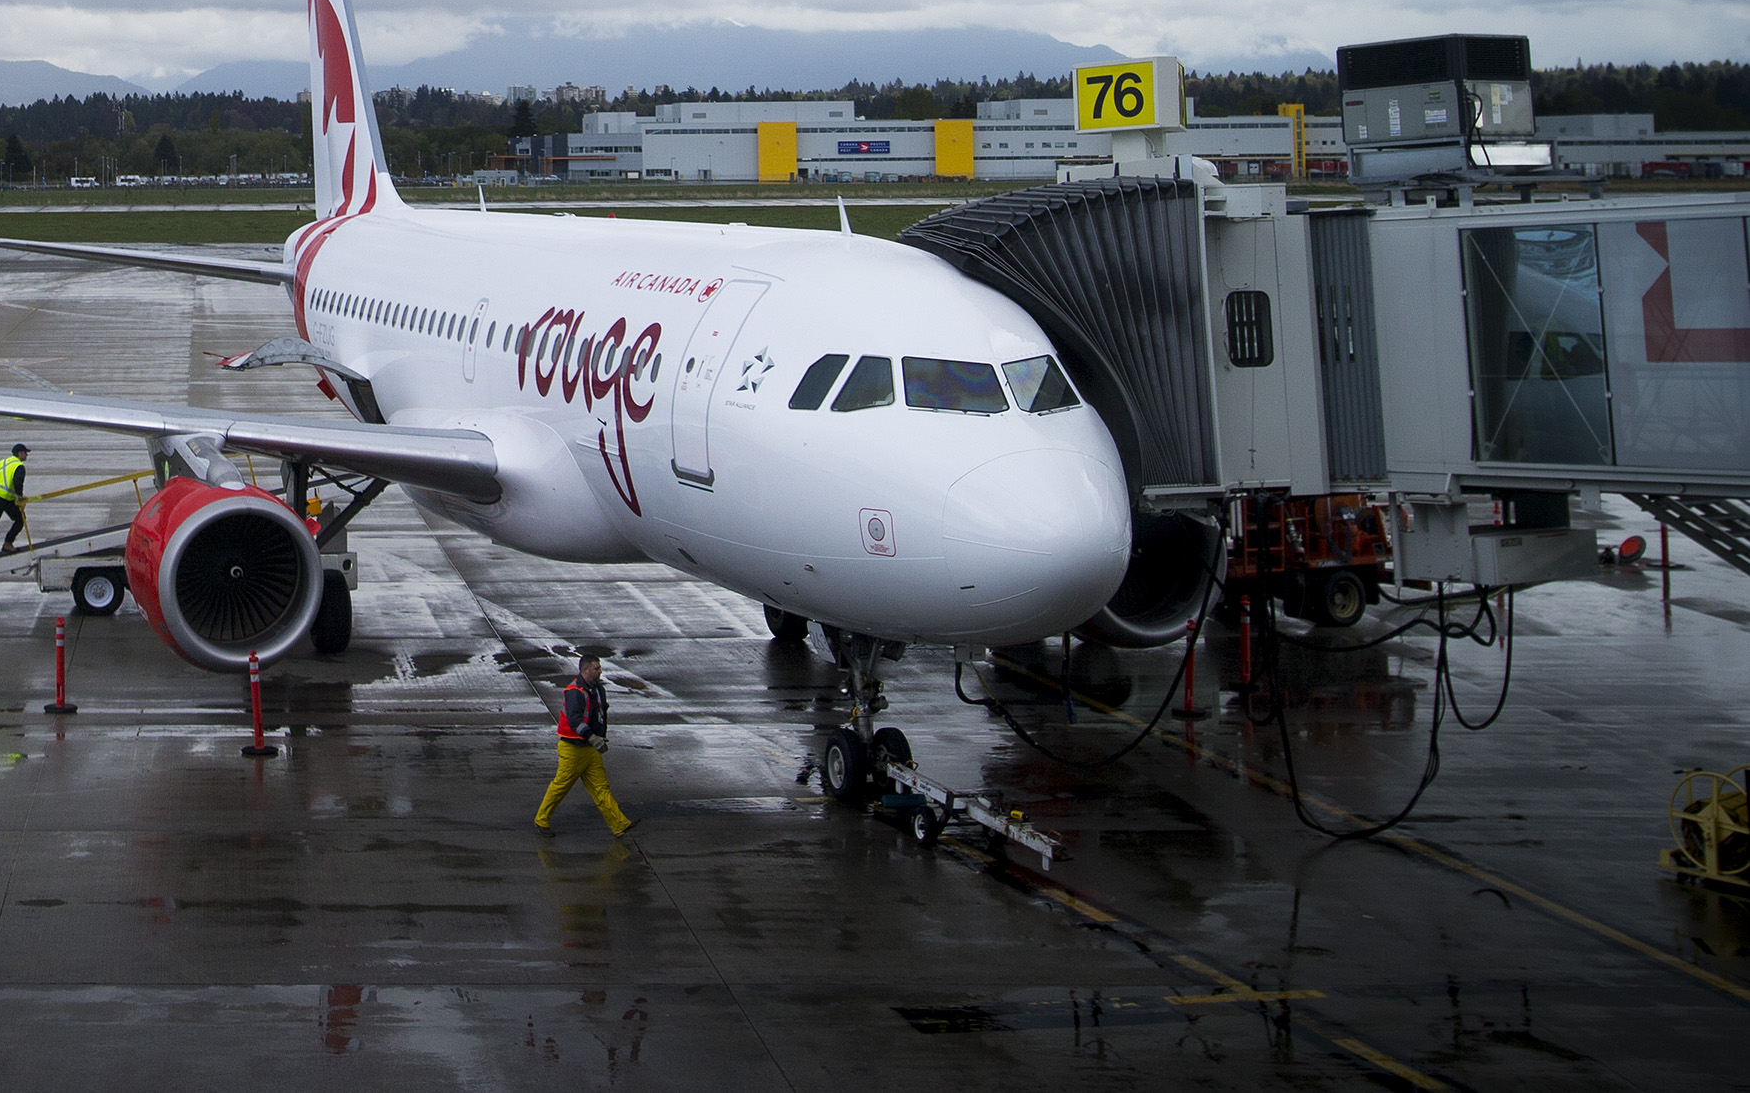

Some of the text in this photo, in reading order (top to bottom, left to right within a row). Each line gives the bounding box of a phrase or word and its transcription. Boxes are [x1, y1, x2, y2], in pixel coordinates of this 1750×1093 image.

[1086, 72, 1145, 119] 76
[610, 271, 701, 296] AIR CANADA
[517, 306, 662, 518] rouge
